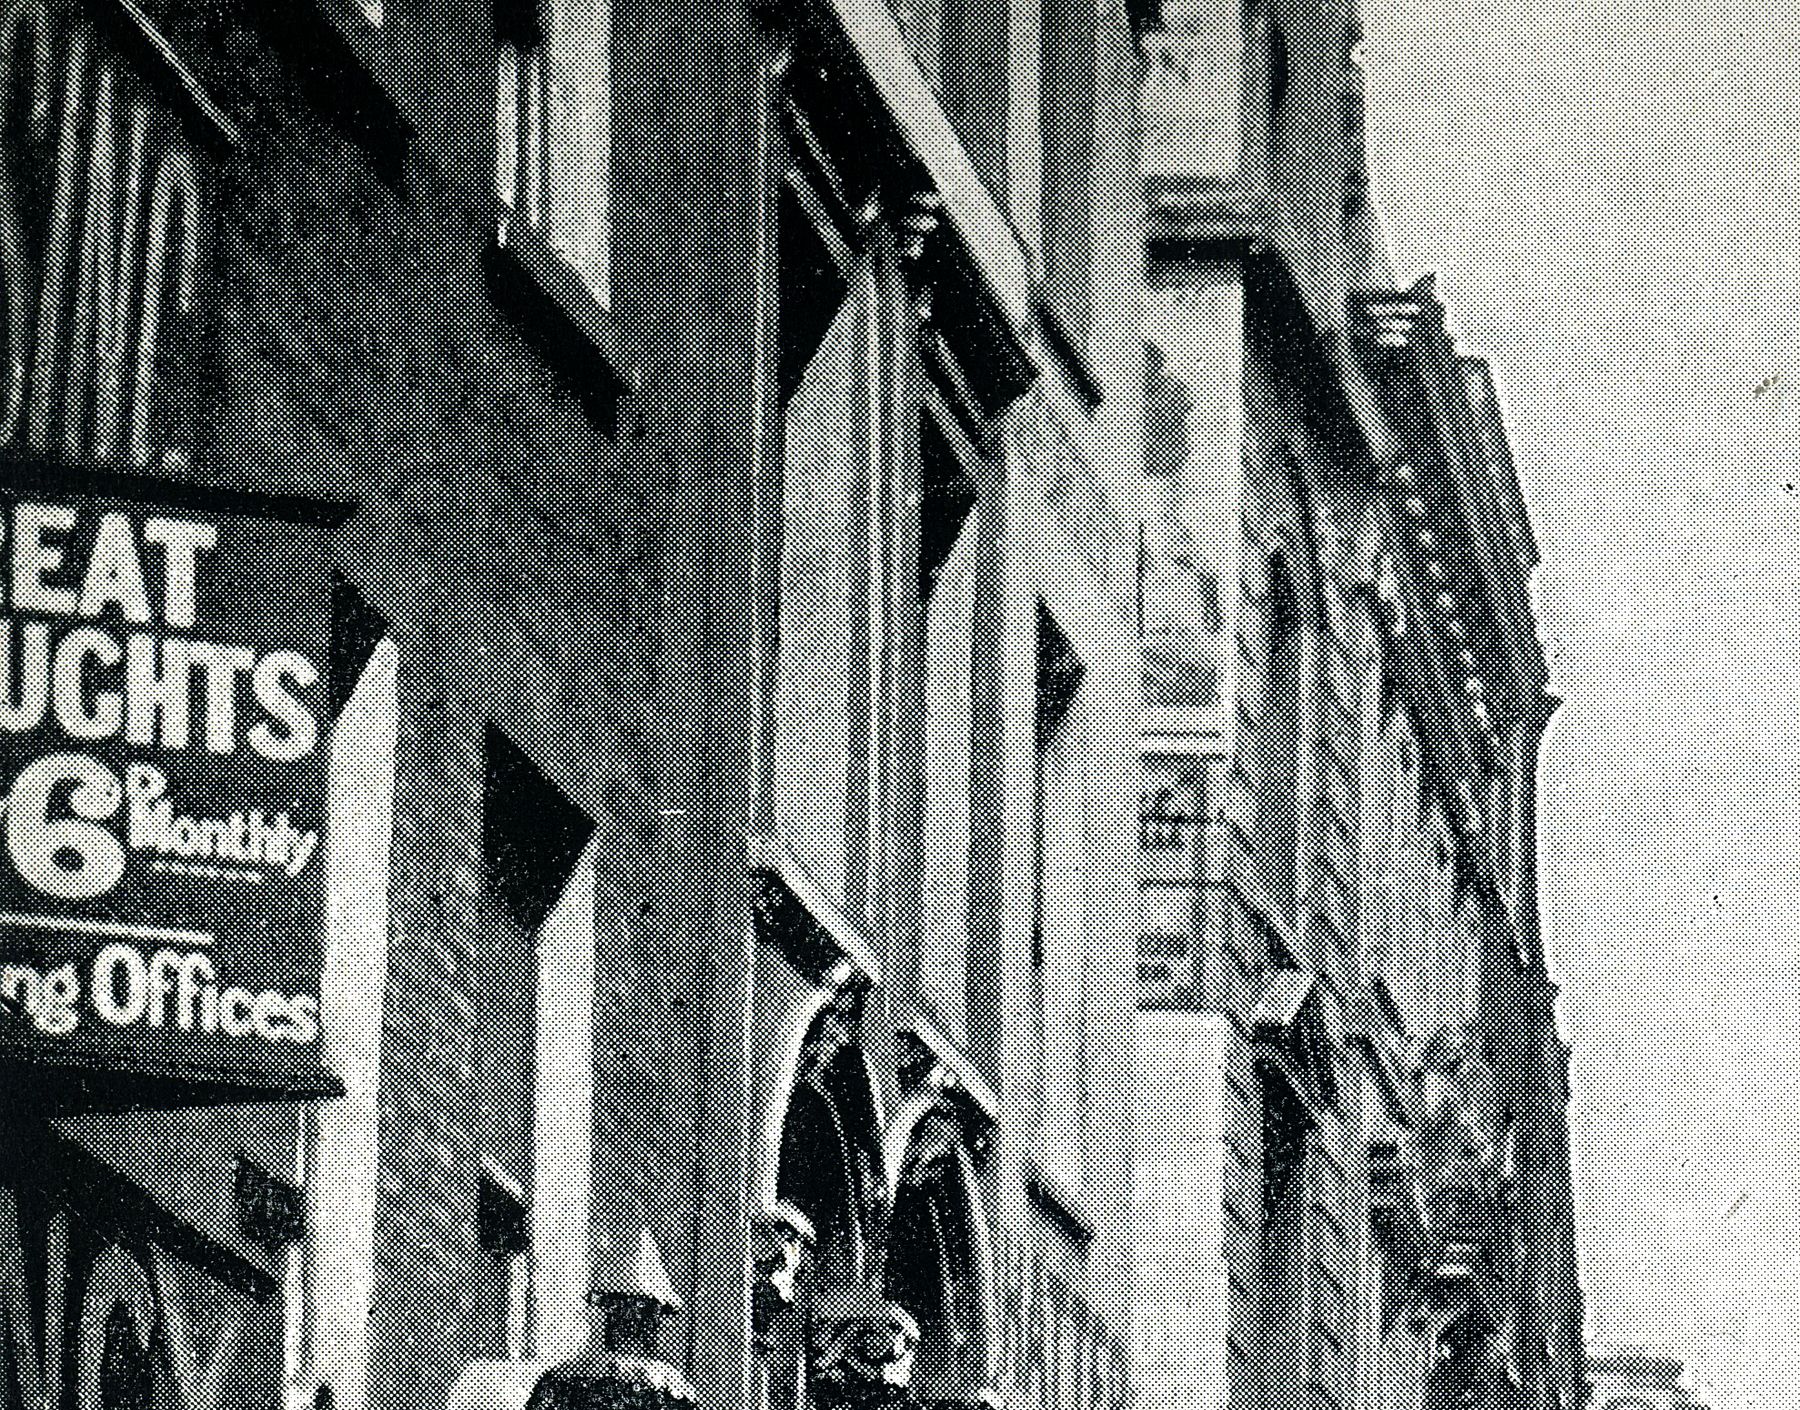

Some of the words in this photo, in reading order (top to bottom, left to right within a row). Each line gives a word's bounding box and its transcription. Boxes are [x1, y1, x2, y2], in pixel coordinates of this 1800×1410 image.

[0, 498, 220, 630] EAT
[129, 795, 320, 878] Monthly
[90, 944, 321, 1045] Offices
